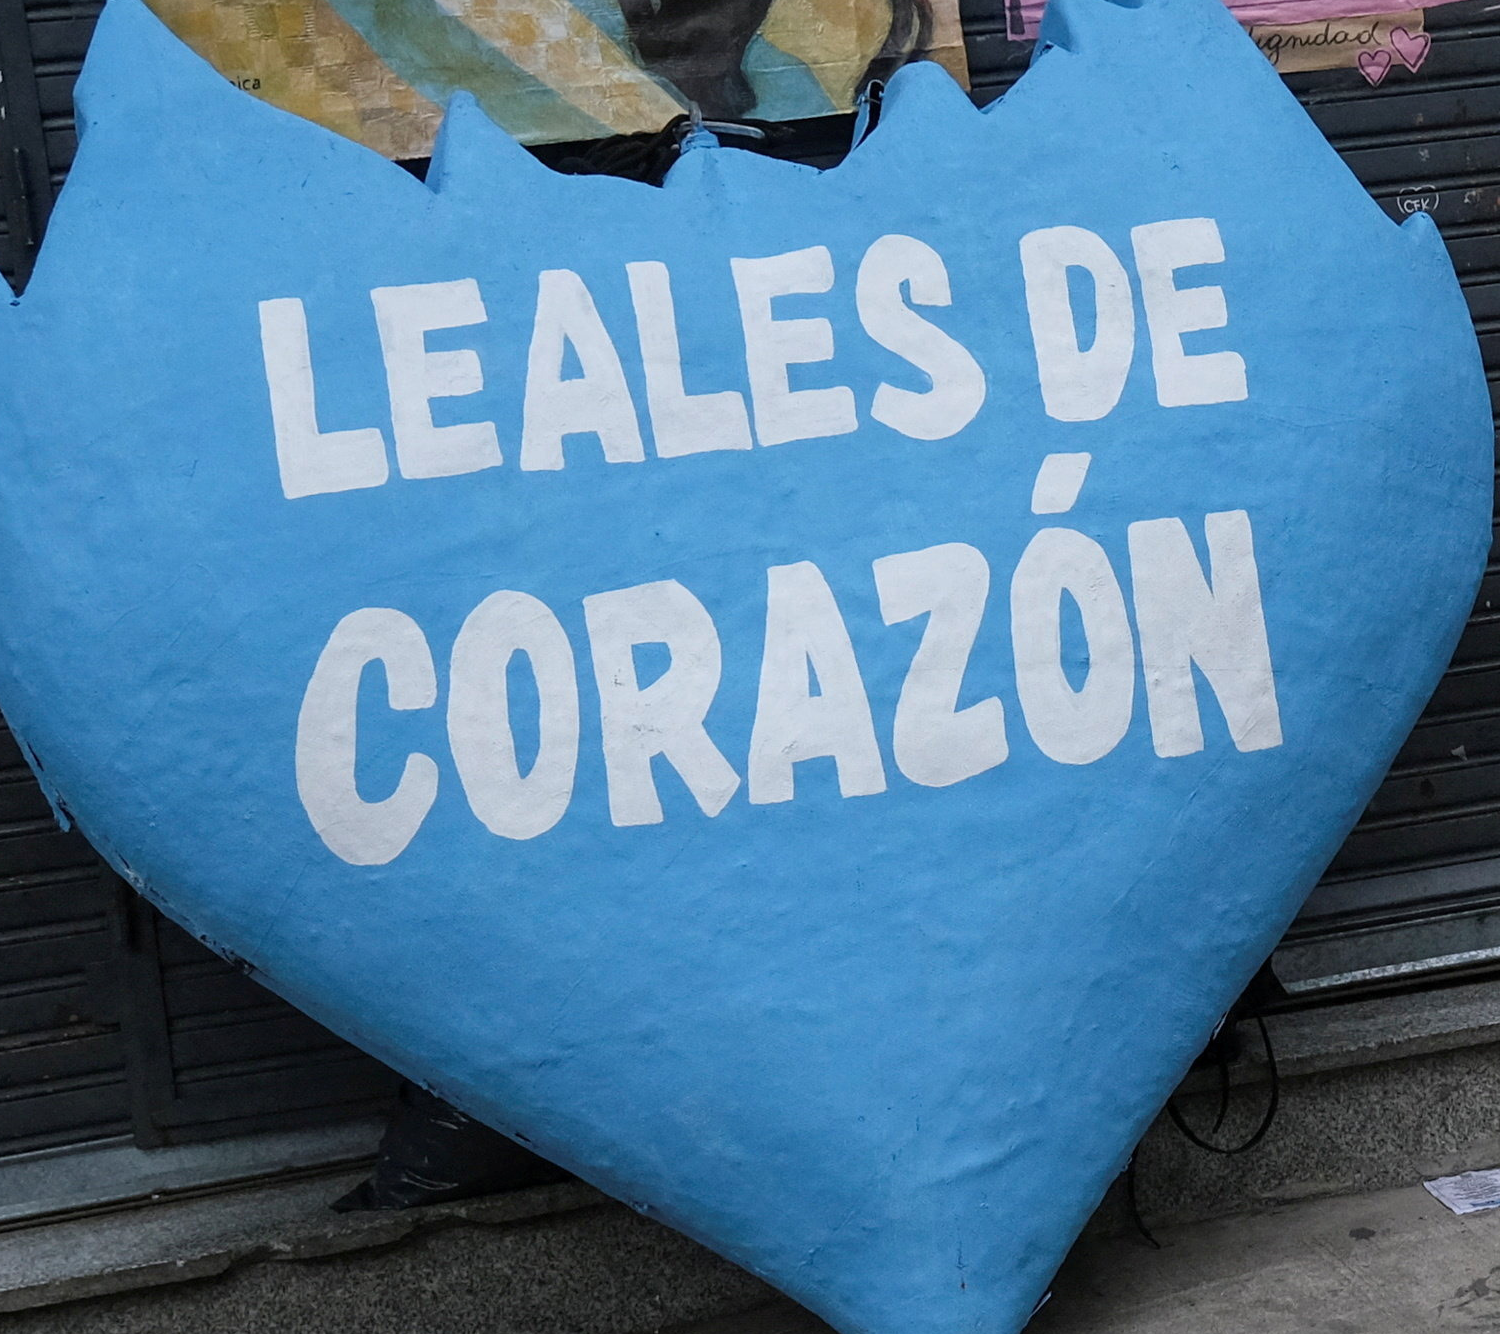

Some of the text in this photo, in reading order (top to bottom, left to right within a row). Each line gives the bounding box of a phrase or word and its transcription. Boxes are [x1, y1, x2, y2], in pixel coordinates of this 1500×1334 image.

[1403, 198, 1430, 213] CFK
[259, 217, 1250, 498] LEALES DE
[295, 451, 1284, 866] CORAZÓN
